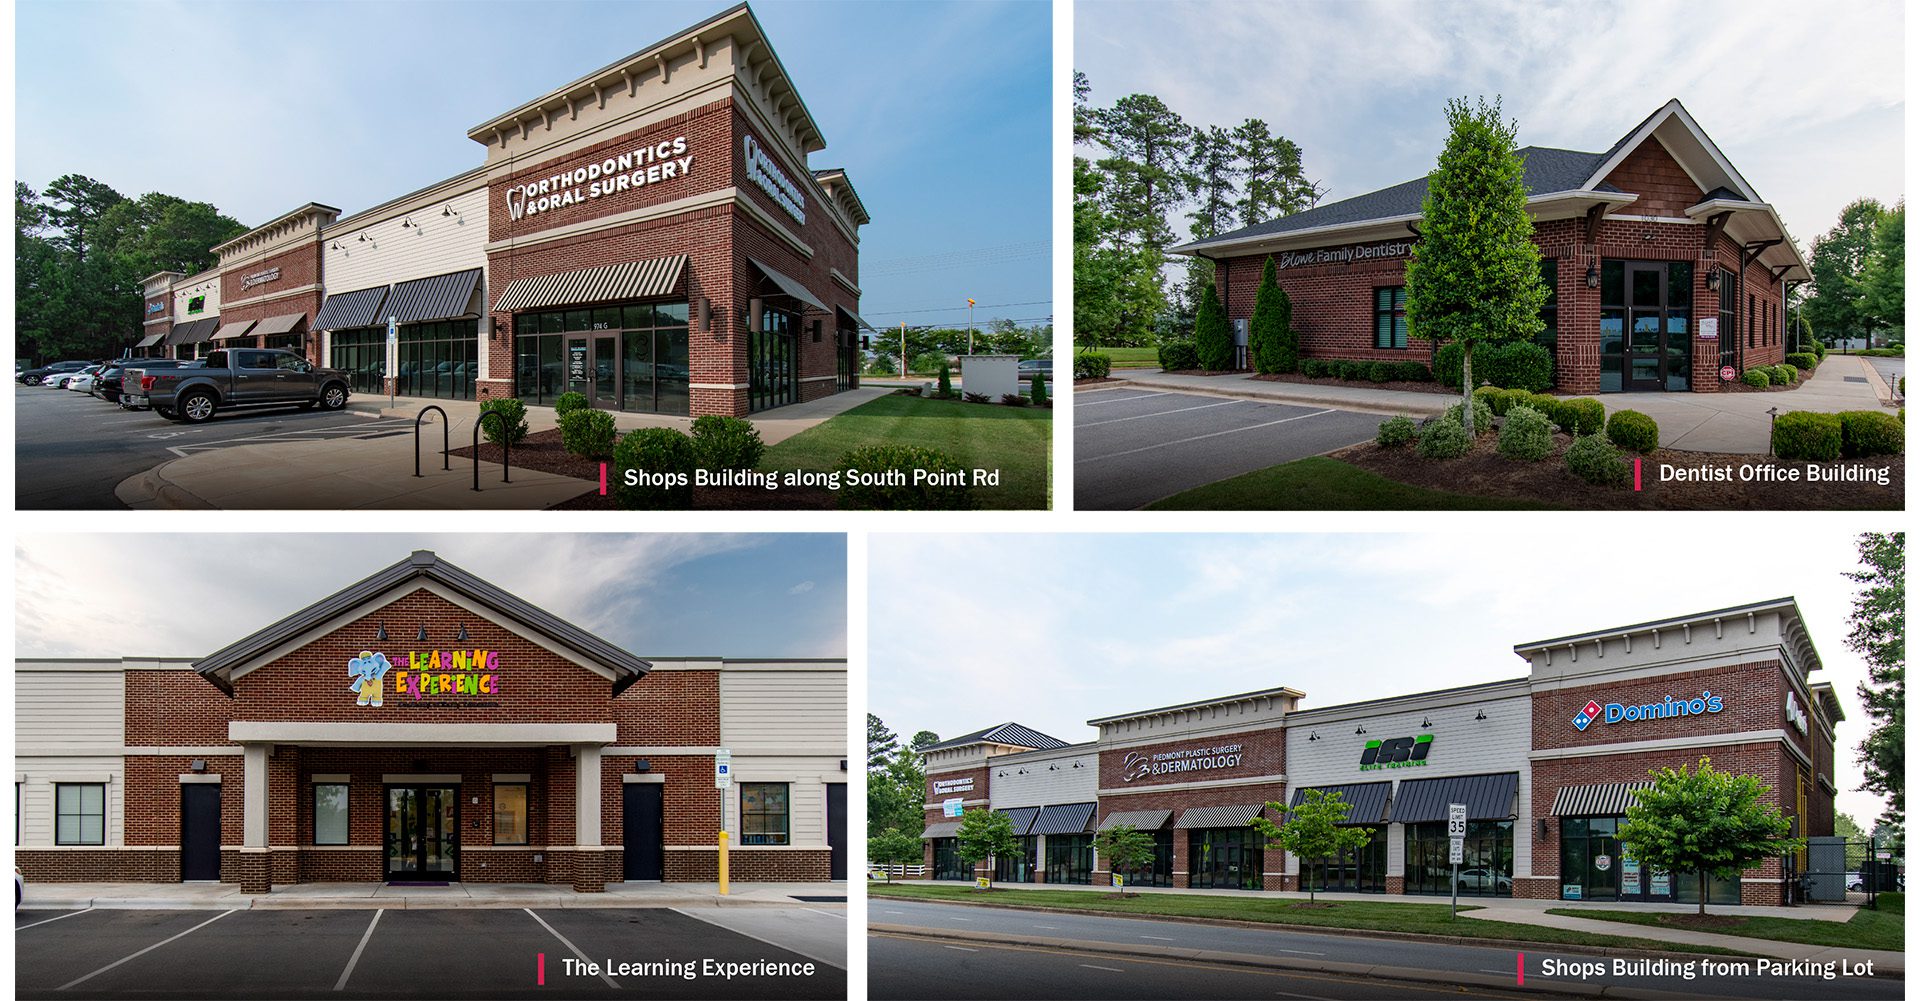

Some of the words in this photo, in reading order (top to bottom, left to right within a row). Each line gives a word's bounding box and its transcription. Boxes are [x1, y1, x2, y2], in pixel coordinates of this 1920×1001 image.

[526, 137, 687, 197] ORTHODONTICS
[526, 189, 585, 215] &ORAL
[590, 156, 694, 198] SURGERY
[1280, 251, 1316, 270] Blowe
[1316, 246, 1354, 262] Family
[1355, 241, 1416, 259] Dentistry
[392, 656, 409, 667] THE
[1605, 691, 1723, 724] Domino's
[1153, 751, 1185, 761] PIEDMONT
[1185, 747, 1211, 758] PLASTIC
[1211, 743, 1242, 755] SURGERY
[1450, 821, 1465, 833] 35
